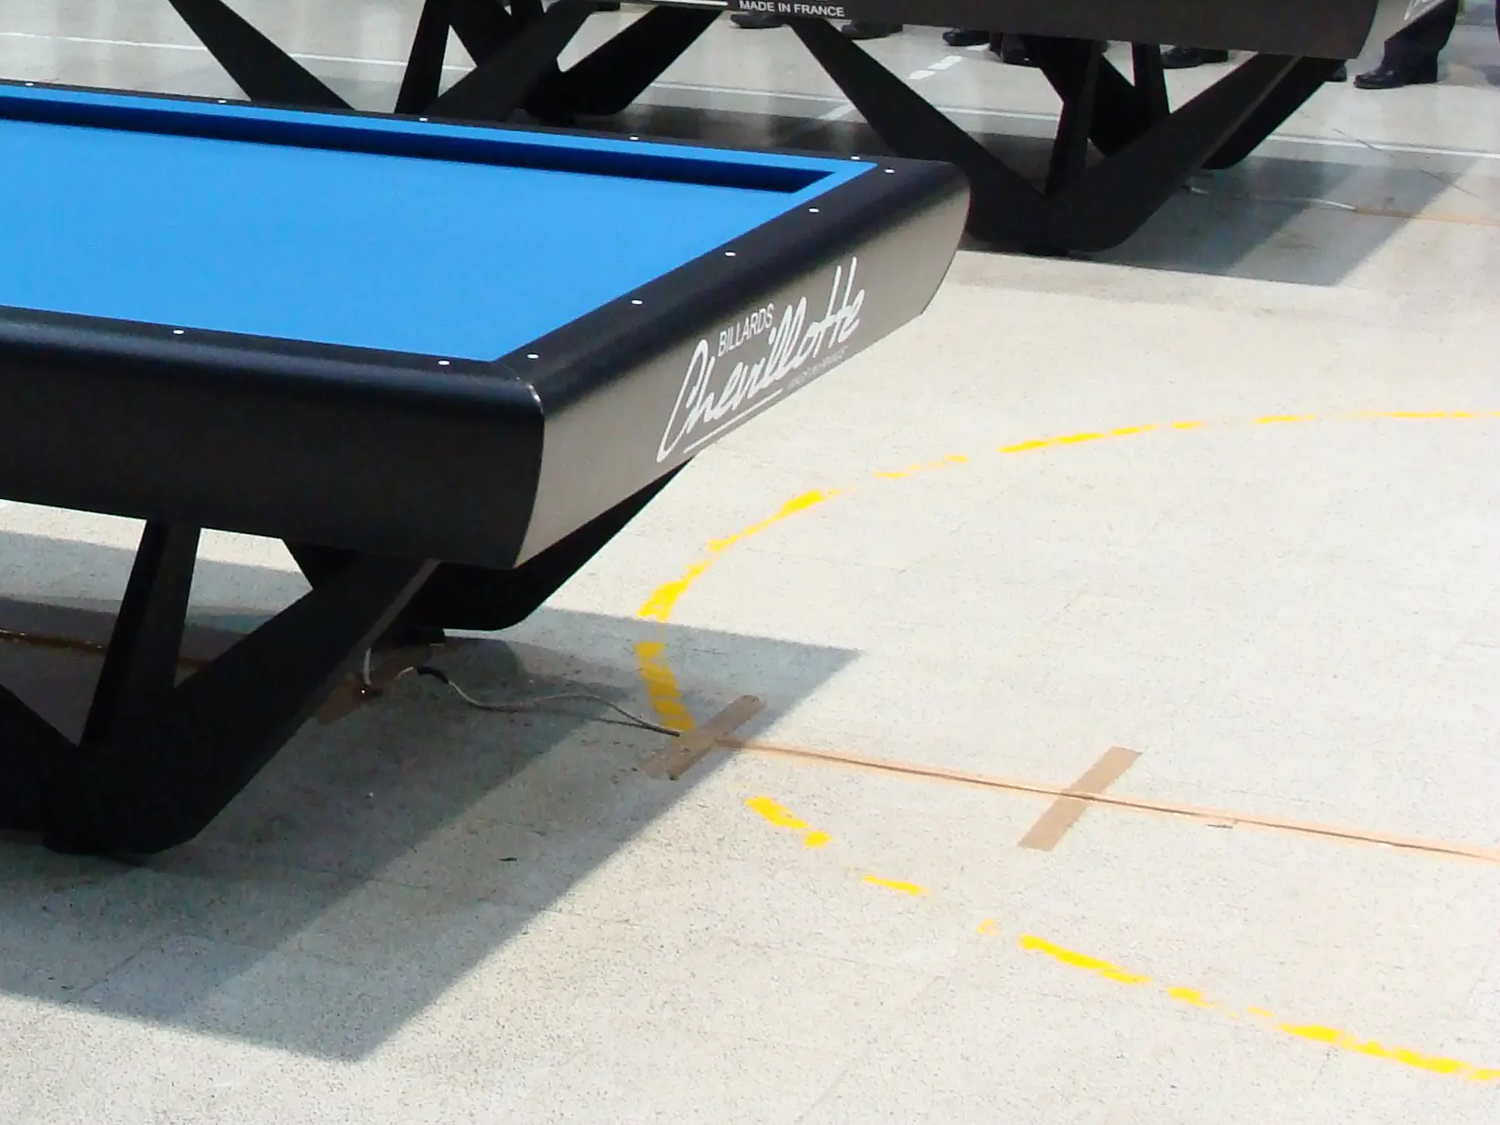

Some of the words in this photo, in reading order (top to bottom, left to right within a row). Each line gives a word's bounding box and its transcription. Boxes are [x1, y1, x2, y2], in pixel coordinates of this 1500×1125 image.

[739, 0, 776, 12] MADE
[778, 3, 791, 13] IN
[794, 3, 846, 18] FRANCE
[718, 302, 775, 357] BILLARDS
[656, 256, 866, 464] Chevillotte
